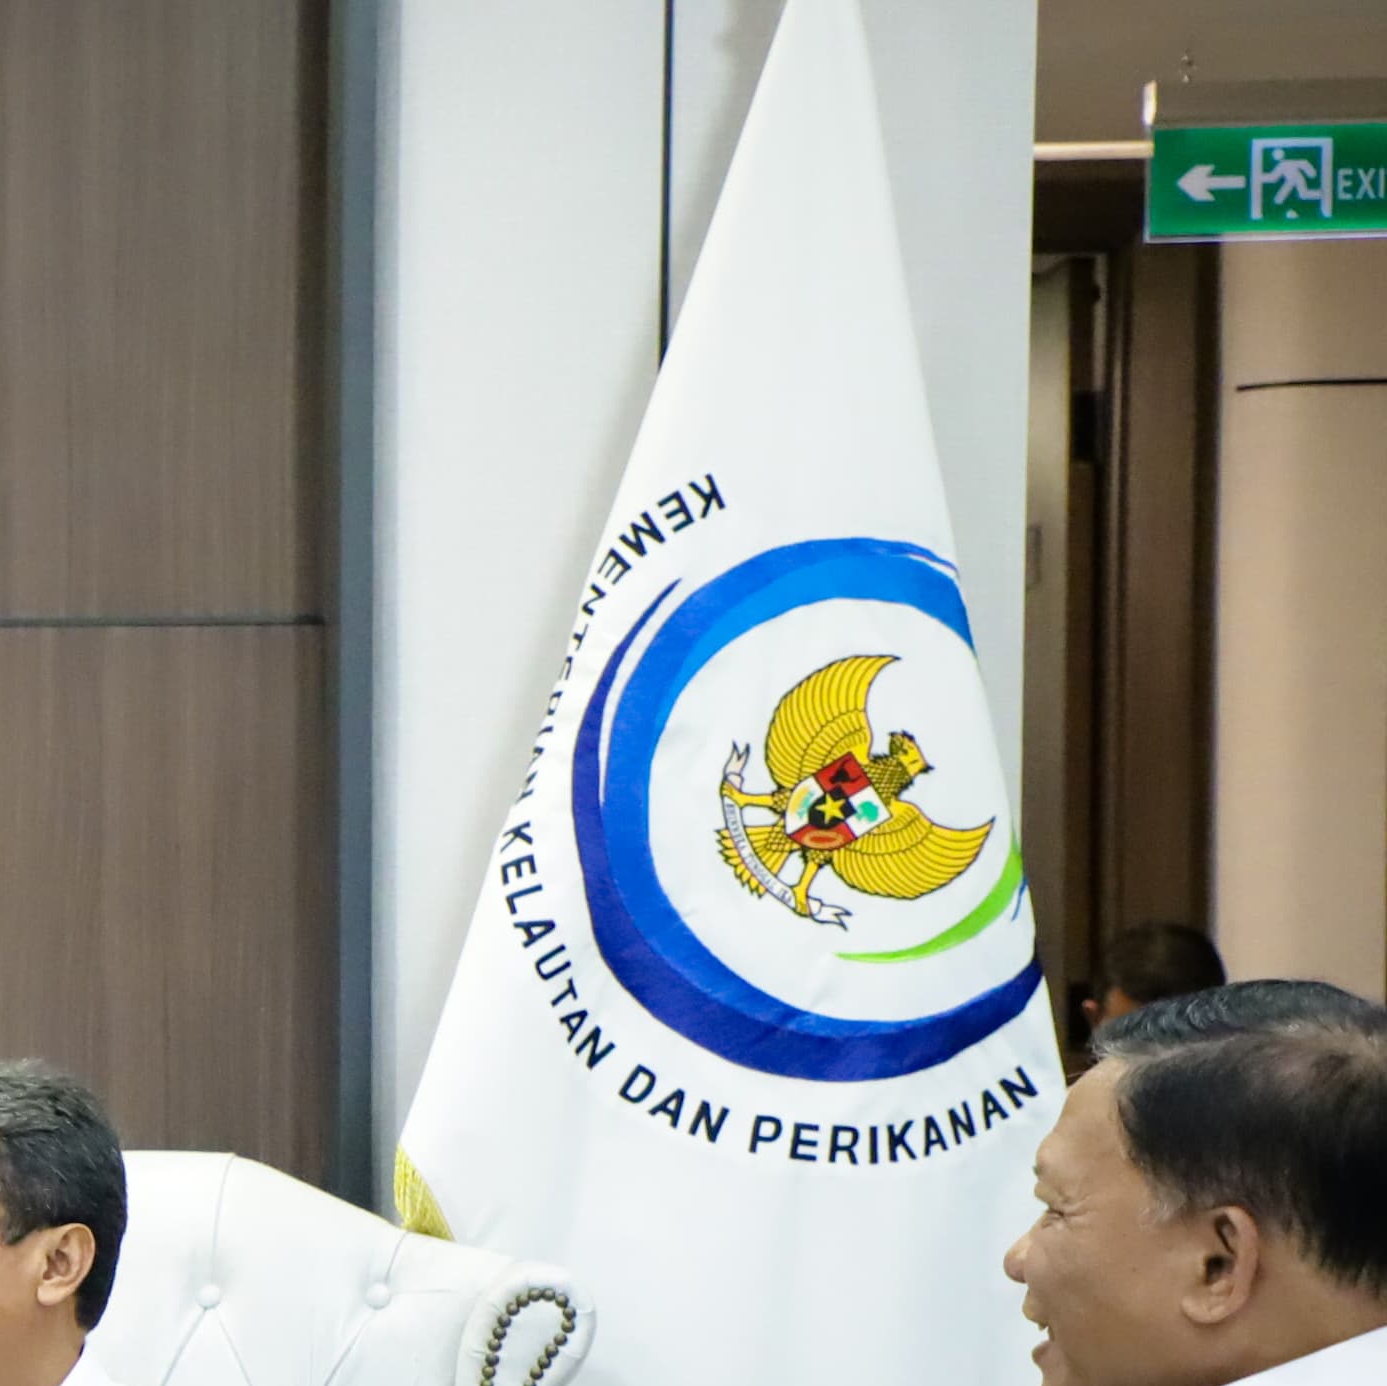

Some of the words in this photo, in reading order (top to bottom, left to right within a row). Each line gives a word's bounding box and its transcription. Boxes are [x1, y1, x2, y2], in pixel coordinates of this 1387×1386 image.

[1337, 168, 1387, 200] EXI
[501, 823, 617, 1069] KELAUTAN
[618, 1066, 729, 1142] DAN
[749, 1067, 1039, 1164] PERIKANAN
